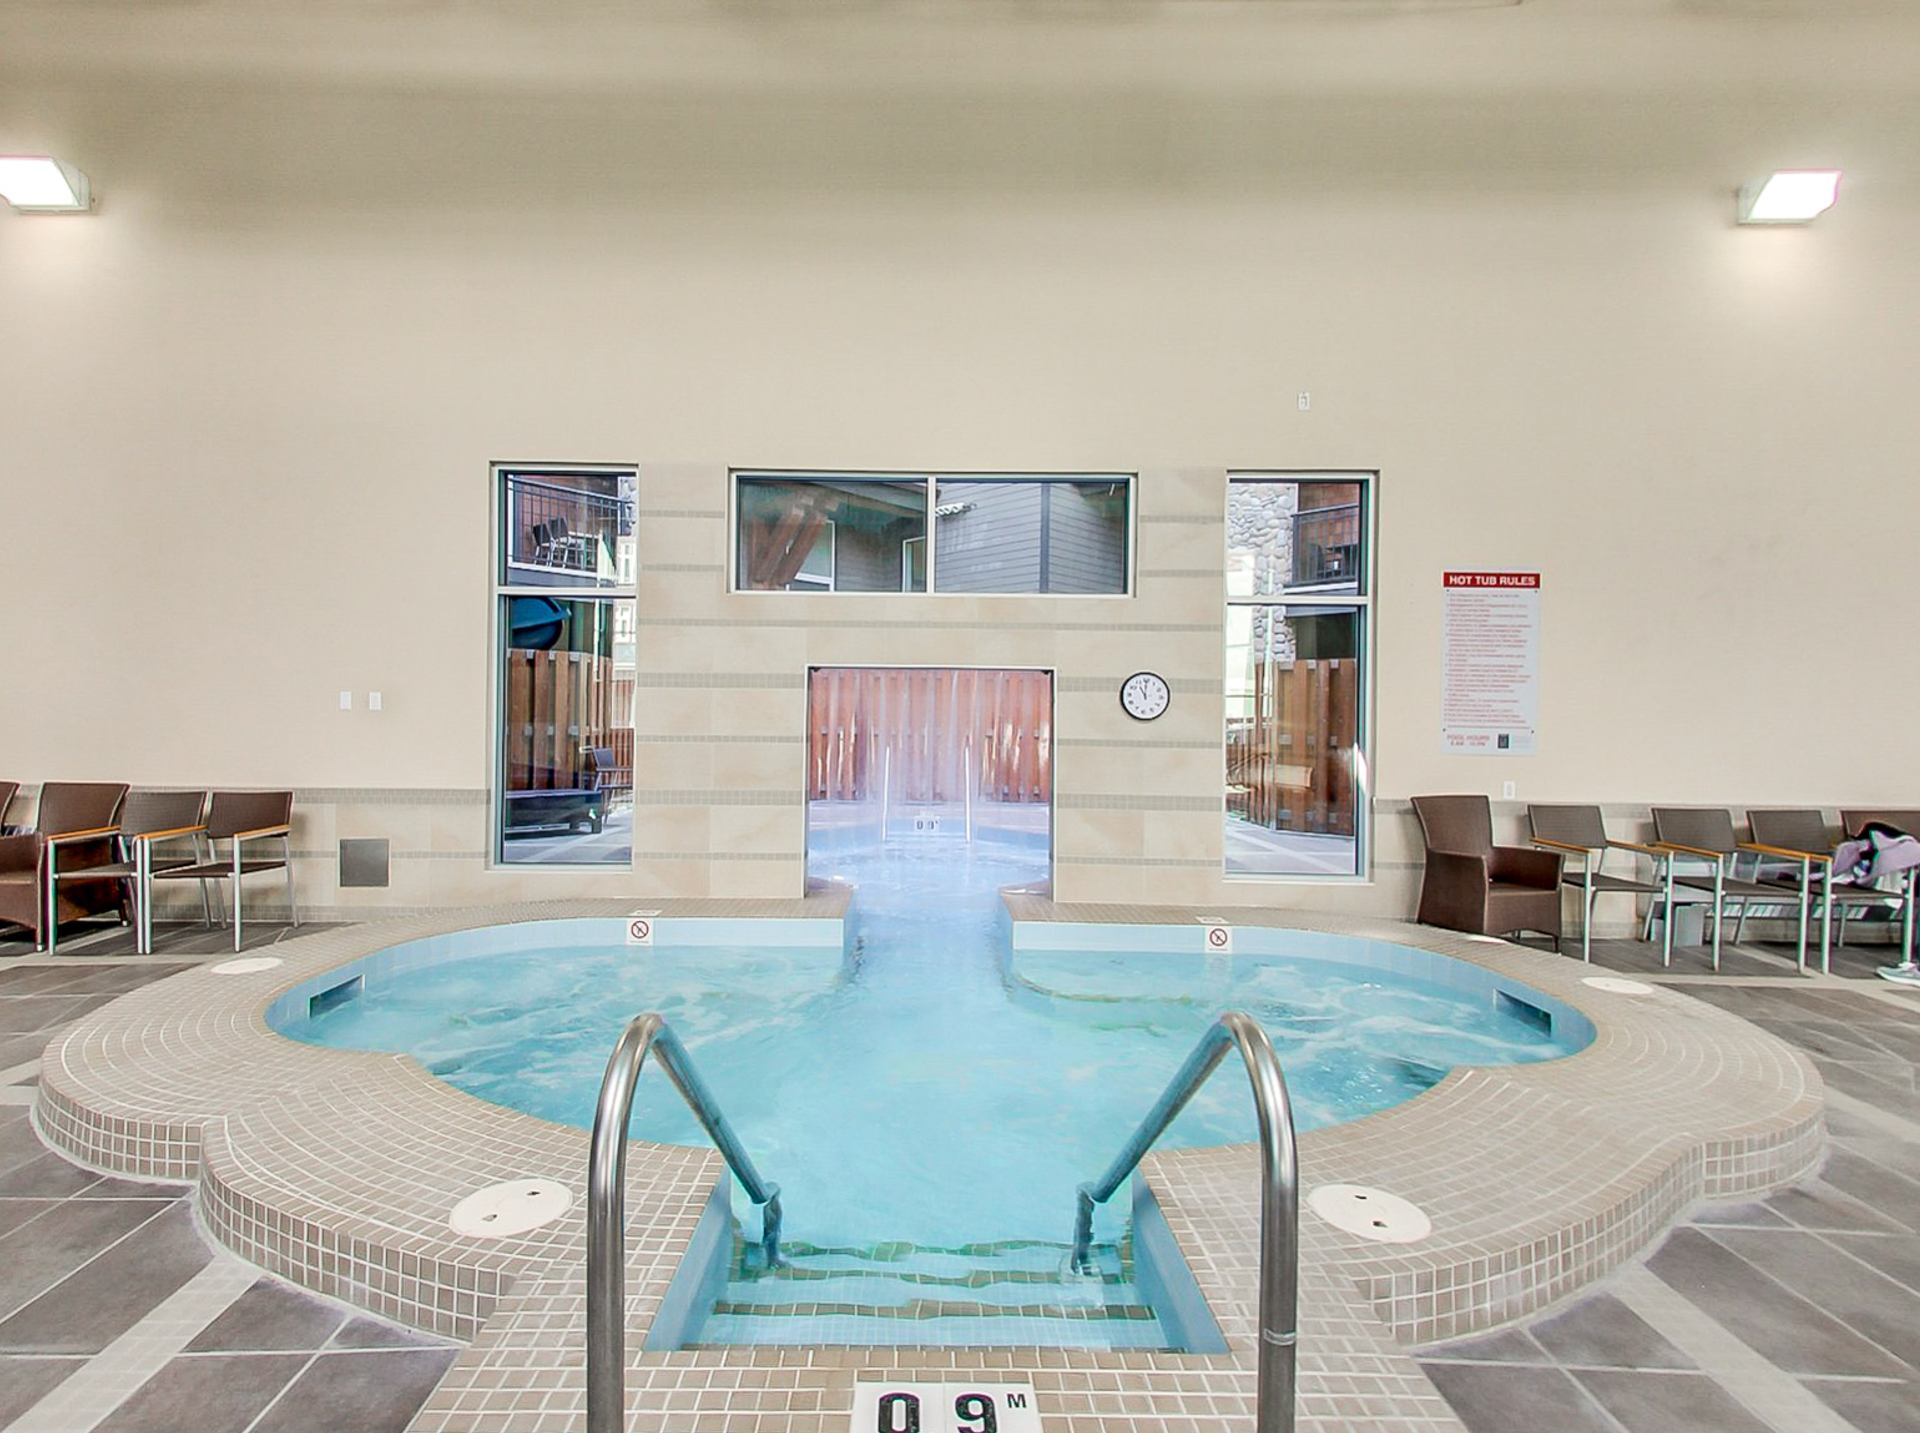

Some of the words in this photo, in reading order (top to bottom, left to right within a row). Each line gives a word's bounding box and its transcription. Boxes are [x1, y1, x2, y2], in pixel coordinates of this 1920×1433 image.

[1449, 575, 1472, 585] HOT
[1475, 576, 1497, 585] TUB
[1500, 576, 1535, 586] RULES
